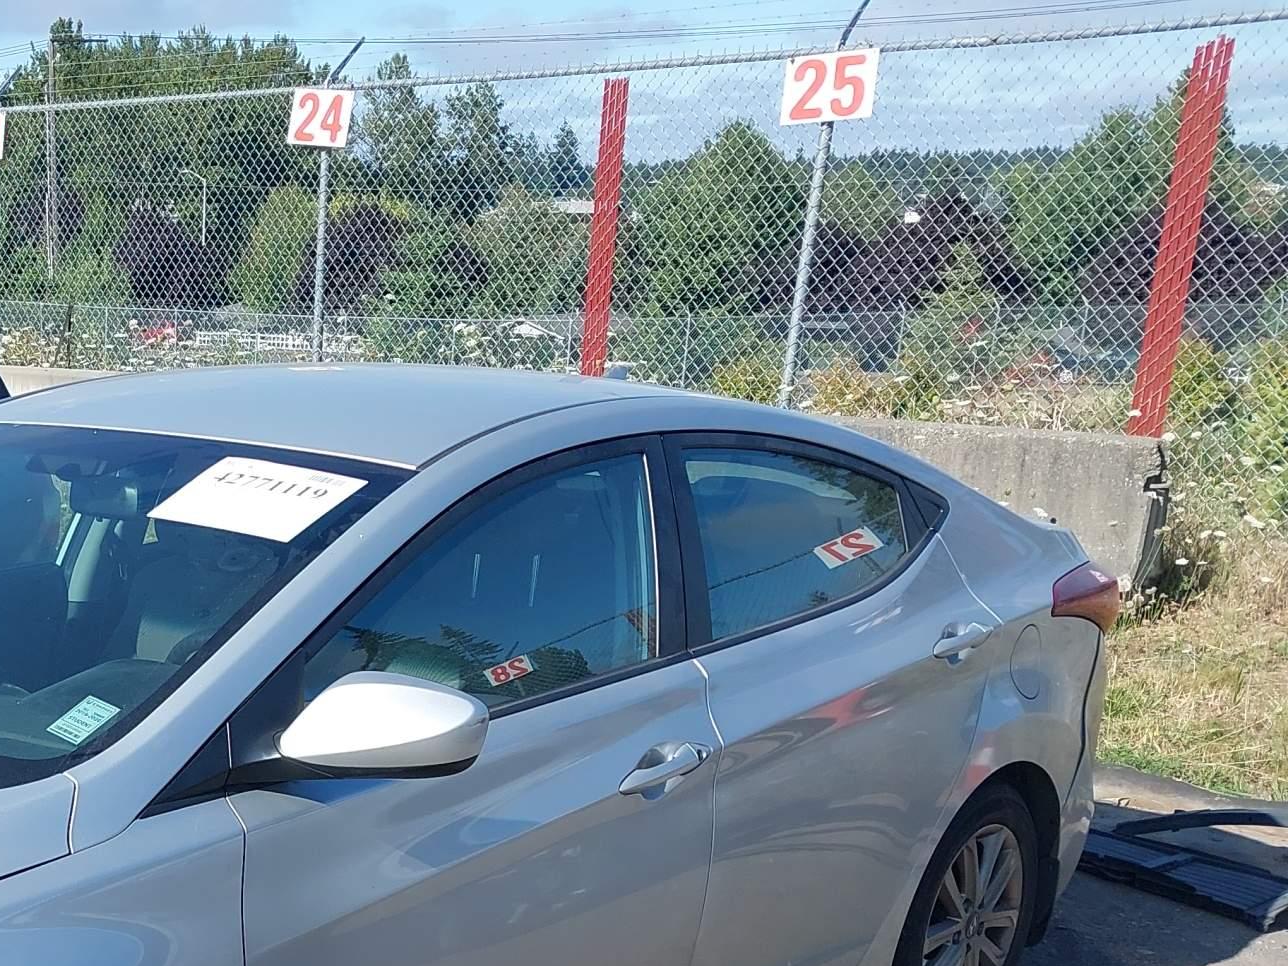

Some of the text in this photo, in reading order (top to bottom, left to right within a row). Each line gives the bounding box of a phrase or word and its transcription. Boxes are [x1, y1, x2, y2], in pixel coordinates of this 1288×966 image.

[789, 54, 866, 120] 25
[294, 93, 343, 142] 24
[214, 472, 328, 499] 42771119
